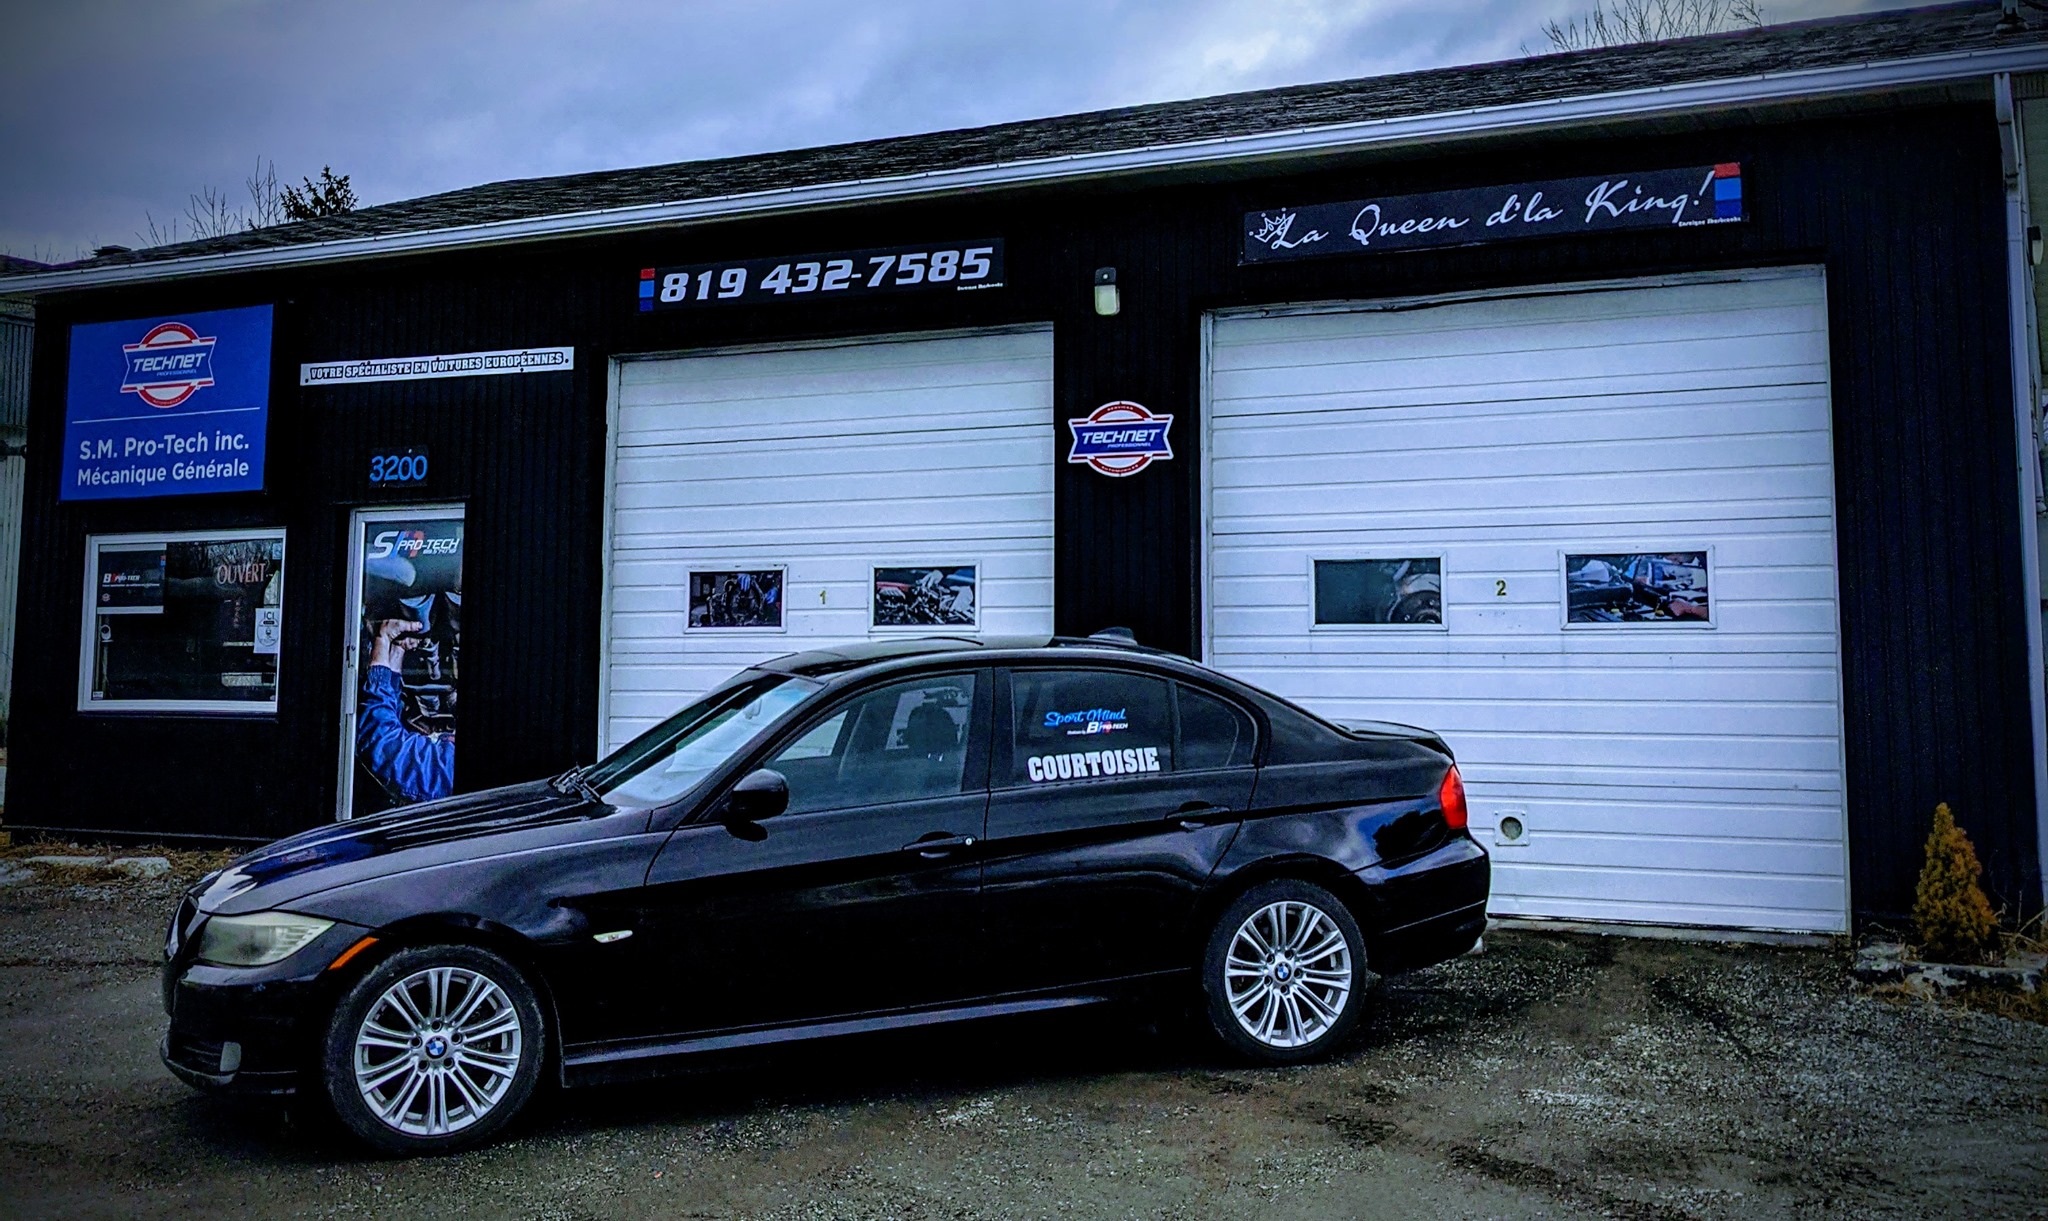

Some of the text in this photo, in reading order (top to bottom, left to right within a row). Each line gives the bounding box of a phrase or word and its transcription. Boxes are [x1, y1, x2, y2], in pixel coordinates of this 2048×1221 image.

[1271, 212, 1329, 249] La
[1348, 204, 1469, 246] Queen
[1584, 169, 1715, 225] King!
[660, 246, 994, 303] 819 432-7585
[133, 352, 207, 373] TECHNET
[309, 352, 564, 380] VOTRE SPÉCIALISTE EN VOITURES EUROPÉENNES
[79, 430, 250, 461] S.M. Pro-Tech inc.
[1081, 428, 1162, 445] TECHNET
[77, 458, 250, 487] Mécanique Générale
[369, 455, 428, 482] 3200
[397, 538, 460, 551] PRO-TECH
[217, 562, 267, 585] OUVERT
[819, 590, 826, 605] 1
[1495, 579, 1507, 597] 2
[1044, 711, 1085, 727] Sport
[1027, 746, 1161, 782] COURTOISIE
